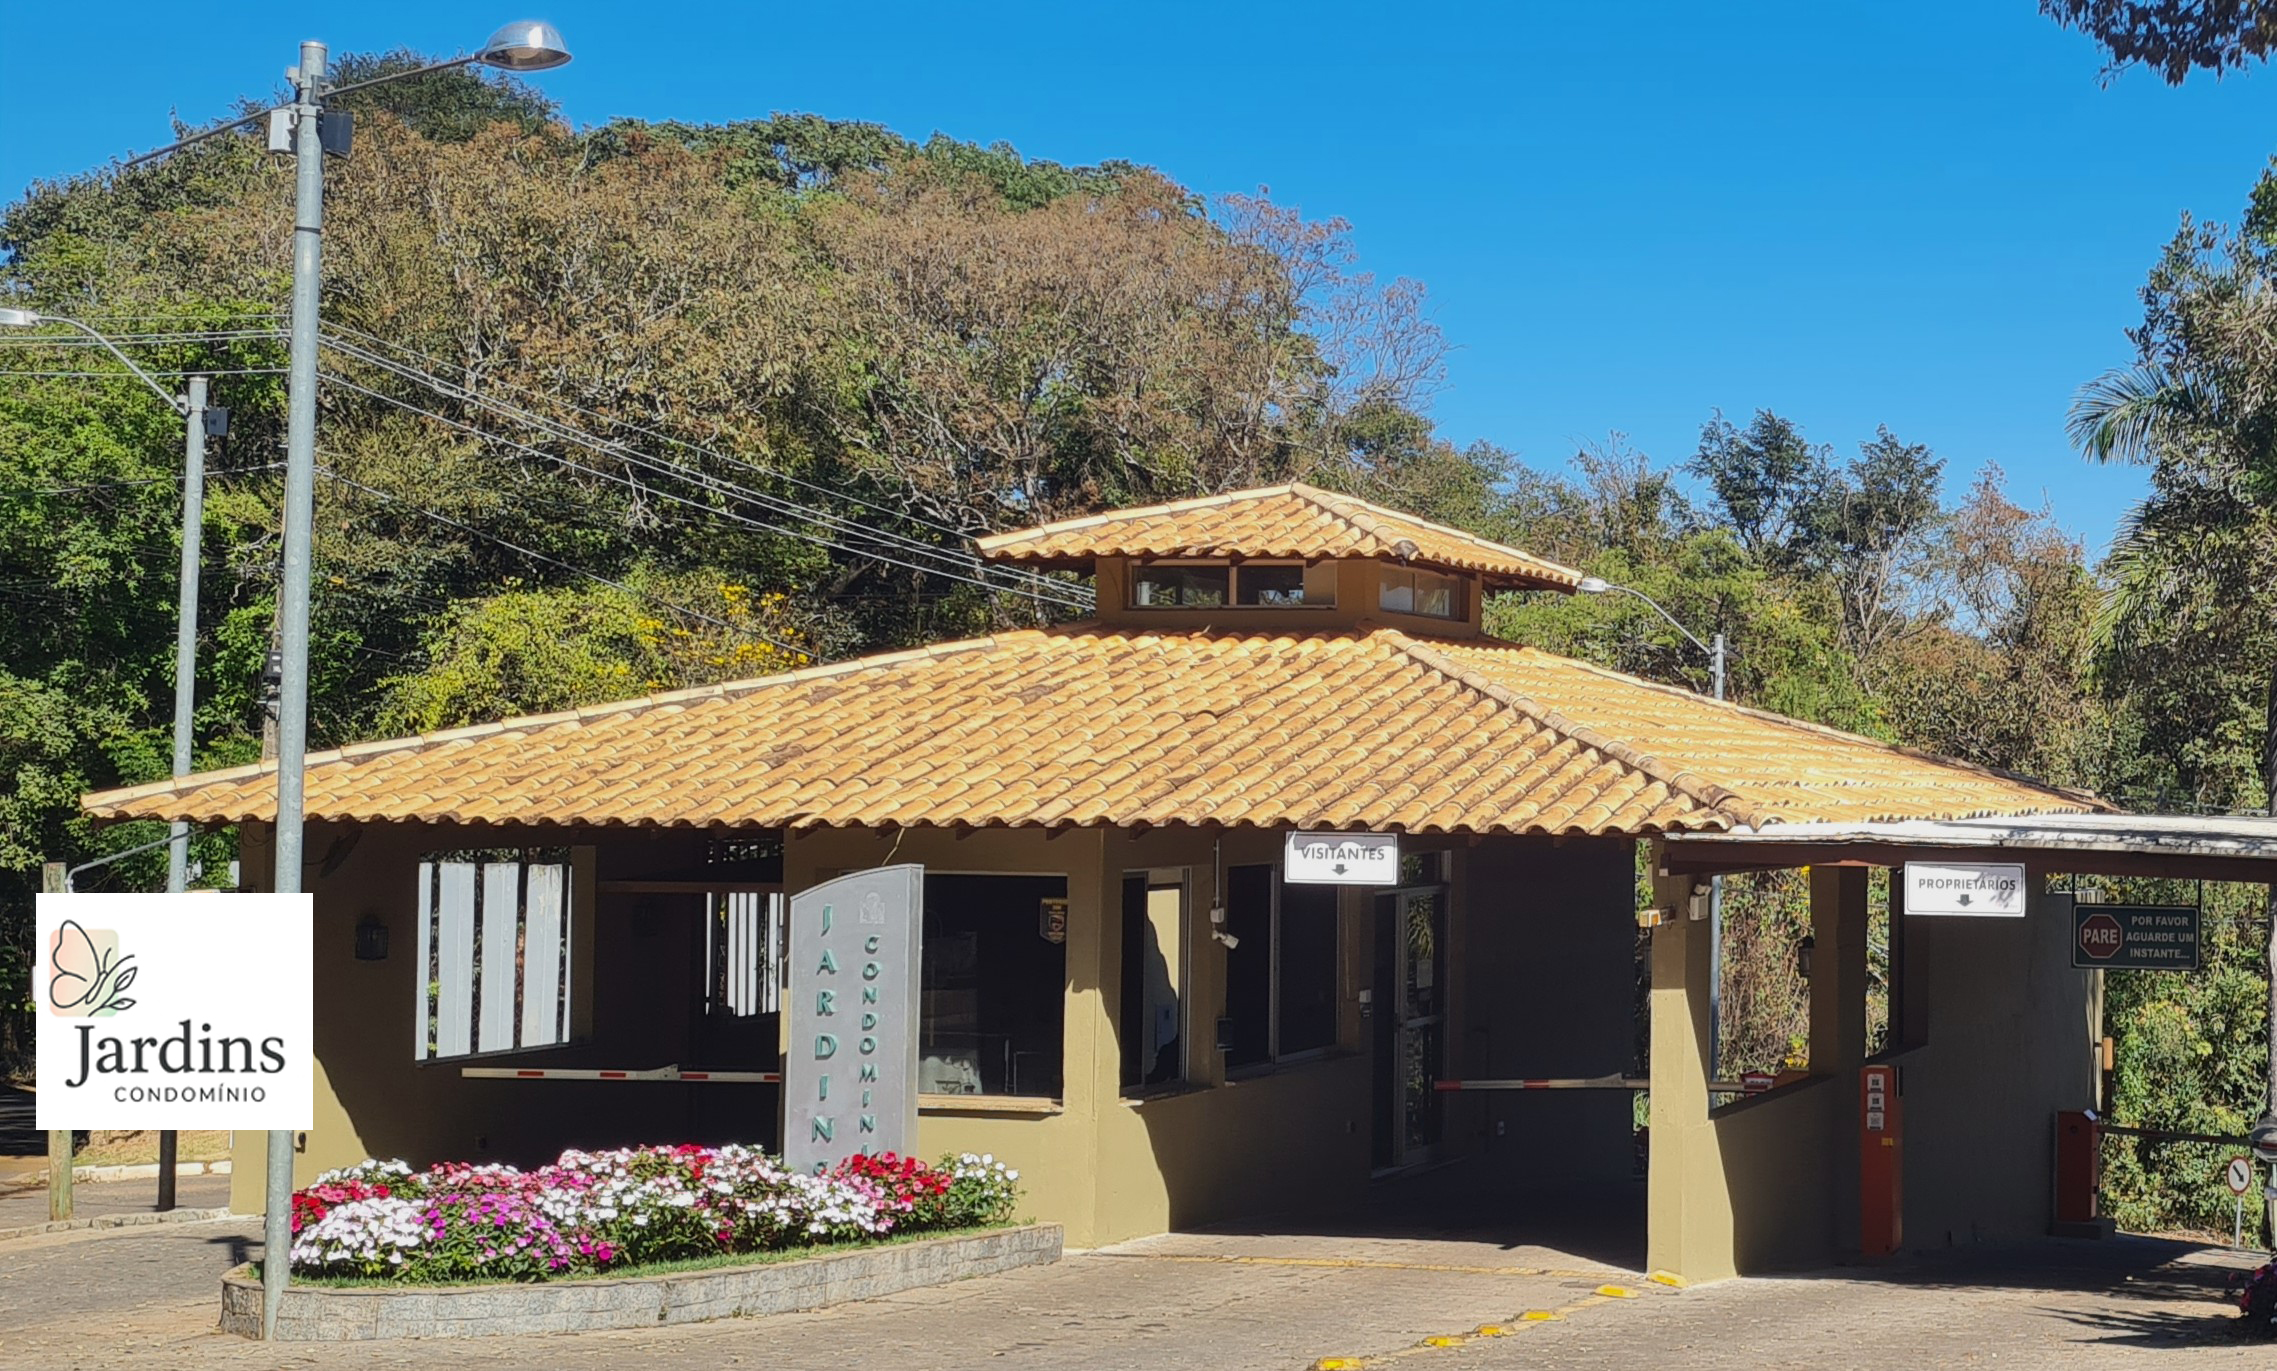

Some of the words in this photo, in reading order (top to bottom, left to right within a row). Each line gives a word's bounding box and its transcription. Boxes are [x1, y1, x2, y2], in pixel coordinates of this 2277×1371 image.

[1301, 847, 1385, 860] VISITANTES
[1919, 875, 2016, 891] PROPRIETÁRIOS
[2131, 915, 2153, 927] POR
[2155, 916, 2189, 927] FAVOR
[2083, 928, 2118, 944] PARE
[2125, 931, 2175, 943] AGUARDE
[2178, 933, 2194, 943] UM
[2129, 947, 2190, 959] INSTANTE...
[859, 934, 883, 1159] CONDOMINI
